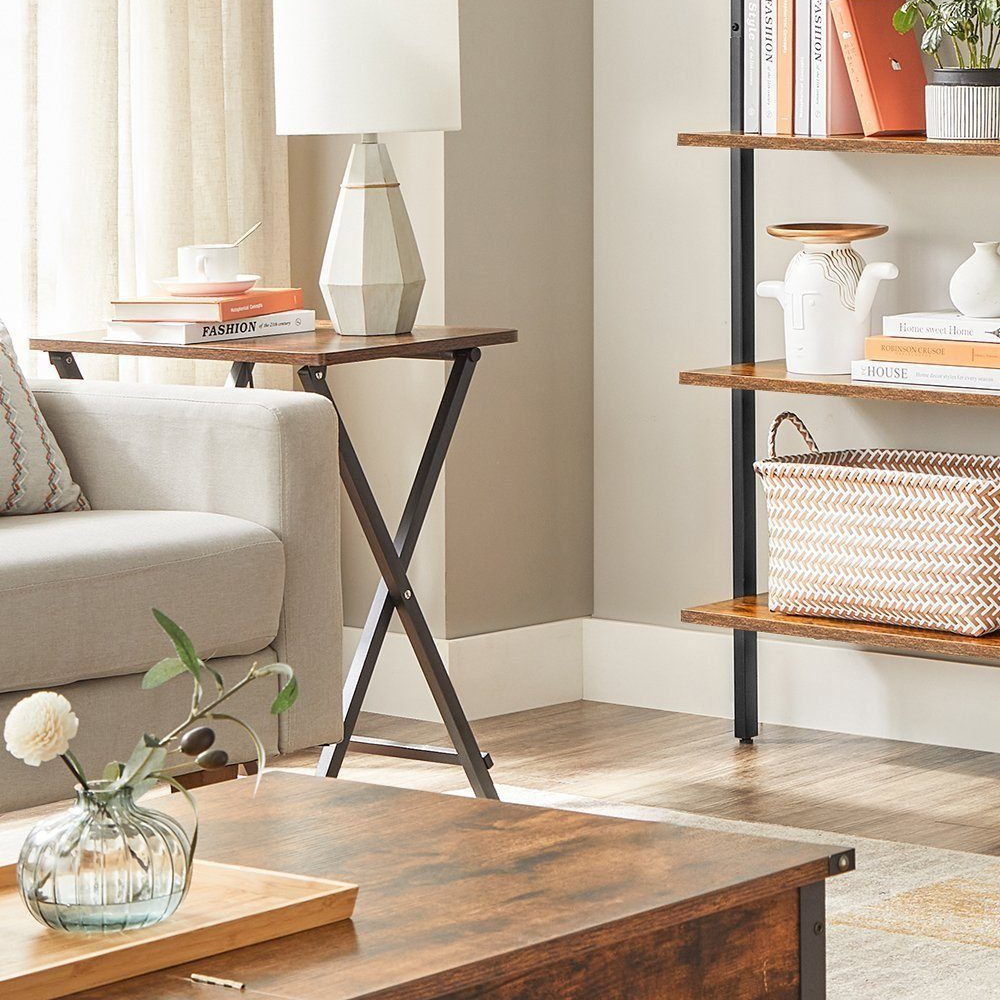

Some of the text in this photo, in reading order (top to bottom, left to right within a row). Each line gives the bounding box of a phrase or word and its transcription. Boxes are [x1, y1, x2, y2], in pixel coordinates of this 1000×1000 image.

[748, 2, 757, 40] Style
[202, 321, 256, 337] FASHION
[899, 322, 974, 336] Home sweet Home
[881, 345, 917, 354] ROBINSON
[918, 347, 945, 355] CRUSOE
[867, 366, 908, 379] HOUSE
